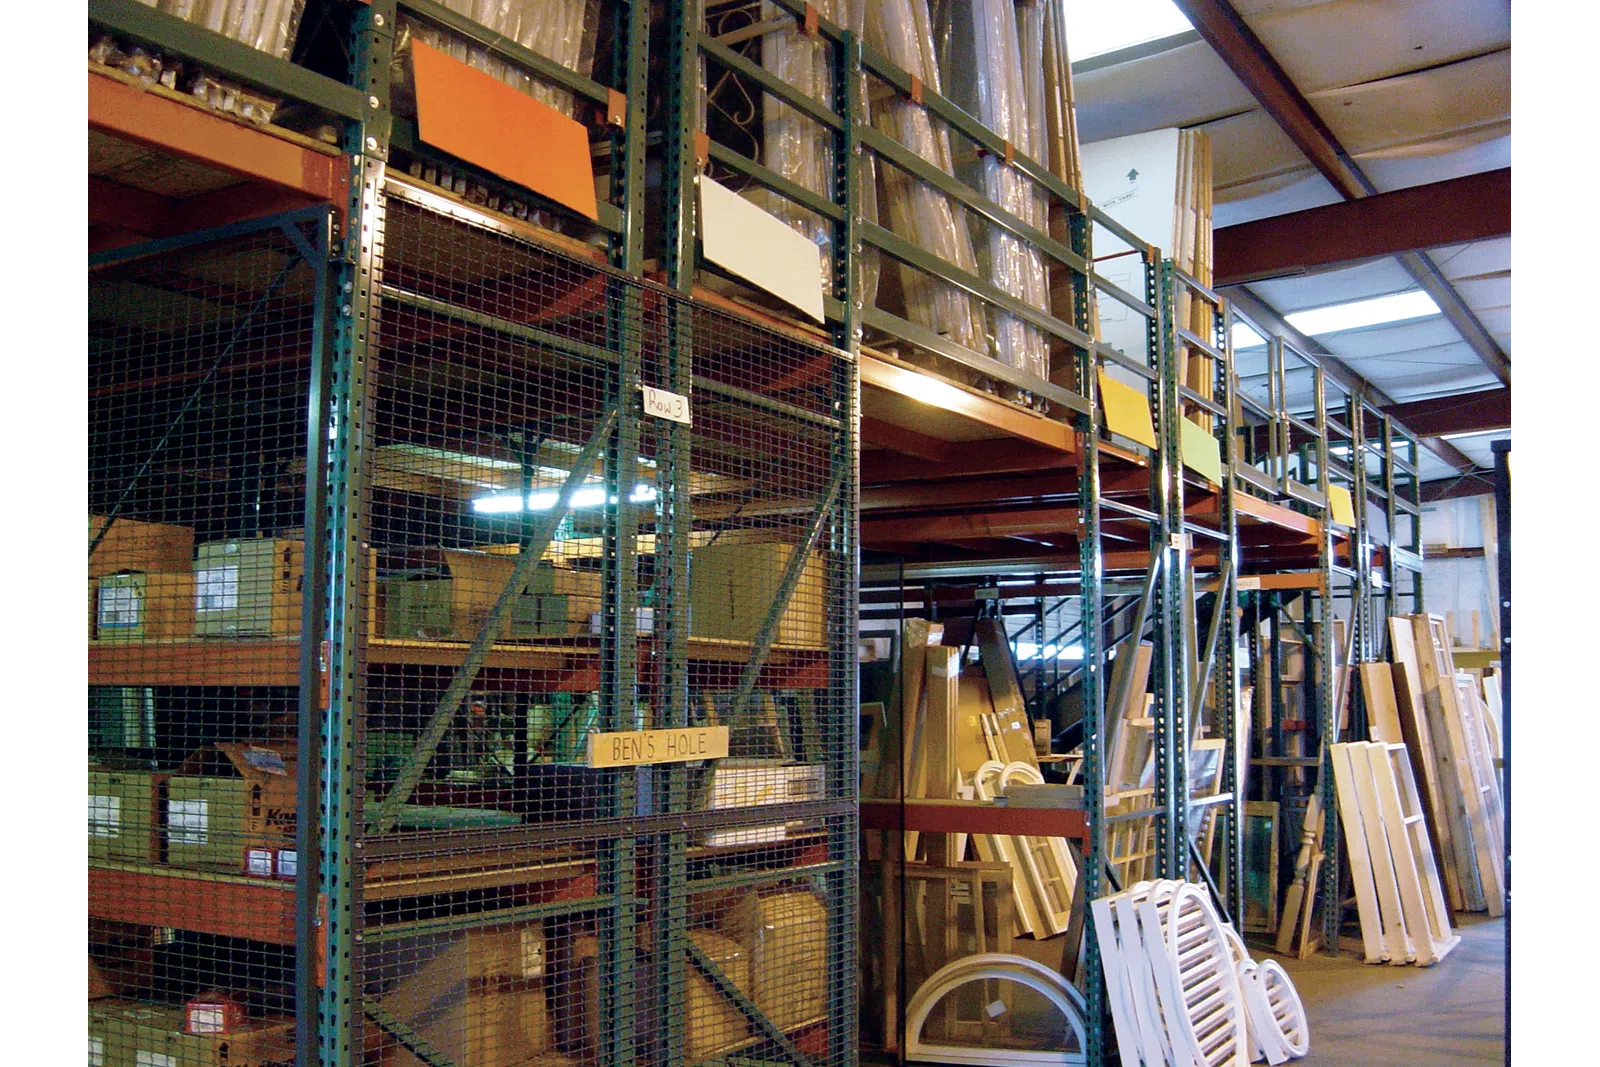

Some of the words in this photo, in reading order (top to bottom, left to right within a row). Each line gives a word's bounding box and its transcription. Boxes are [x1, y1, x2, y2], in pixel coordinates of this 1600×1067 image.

[649, 389, 671, 414] Row
[674, 399, 683, 419] 3
[612, 733, 655, 761] BEN'S
[667, 732, 706, 757] HOLE
